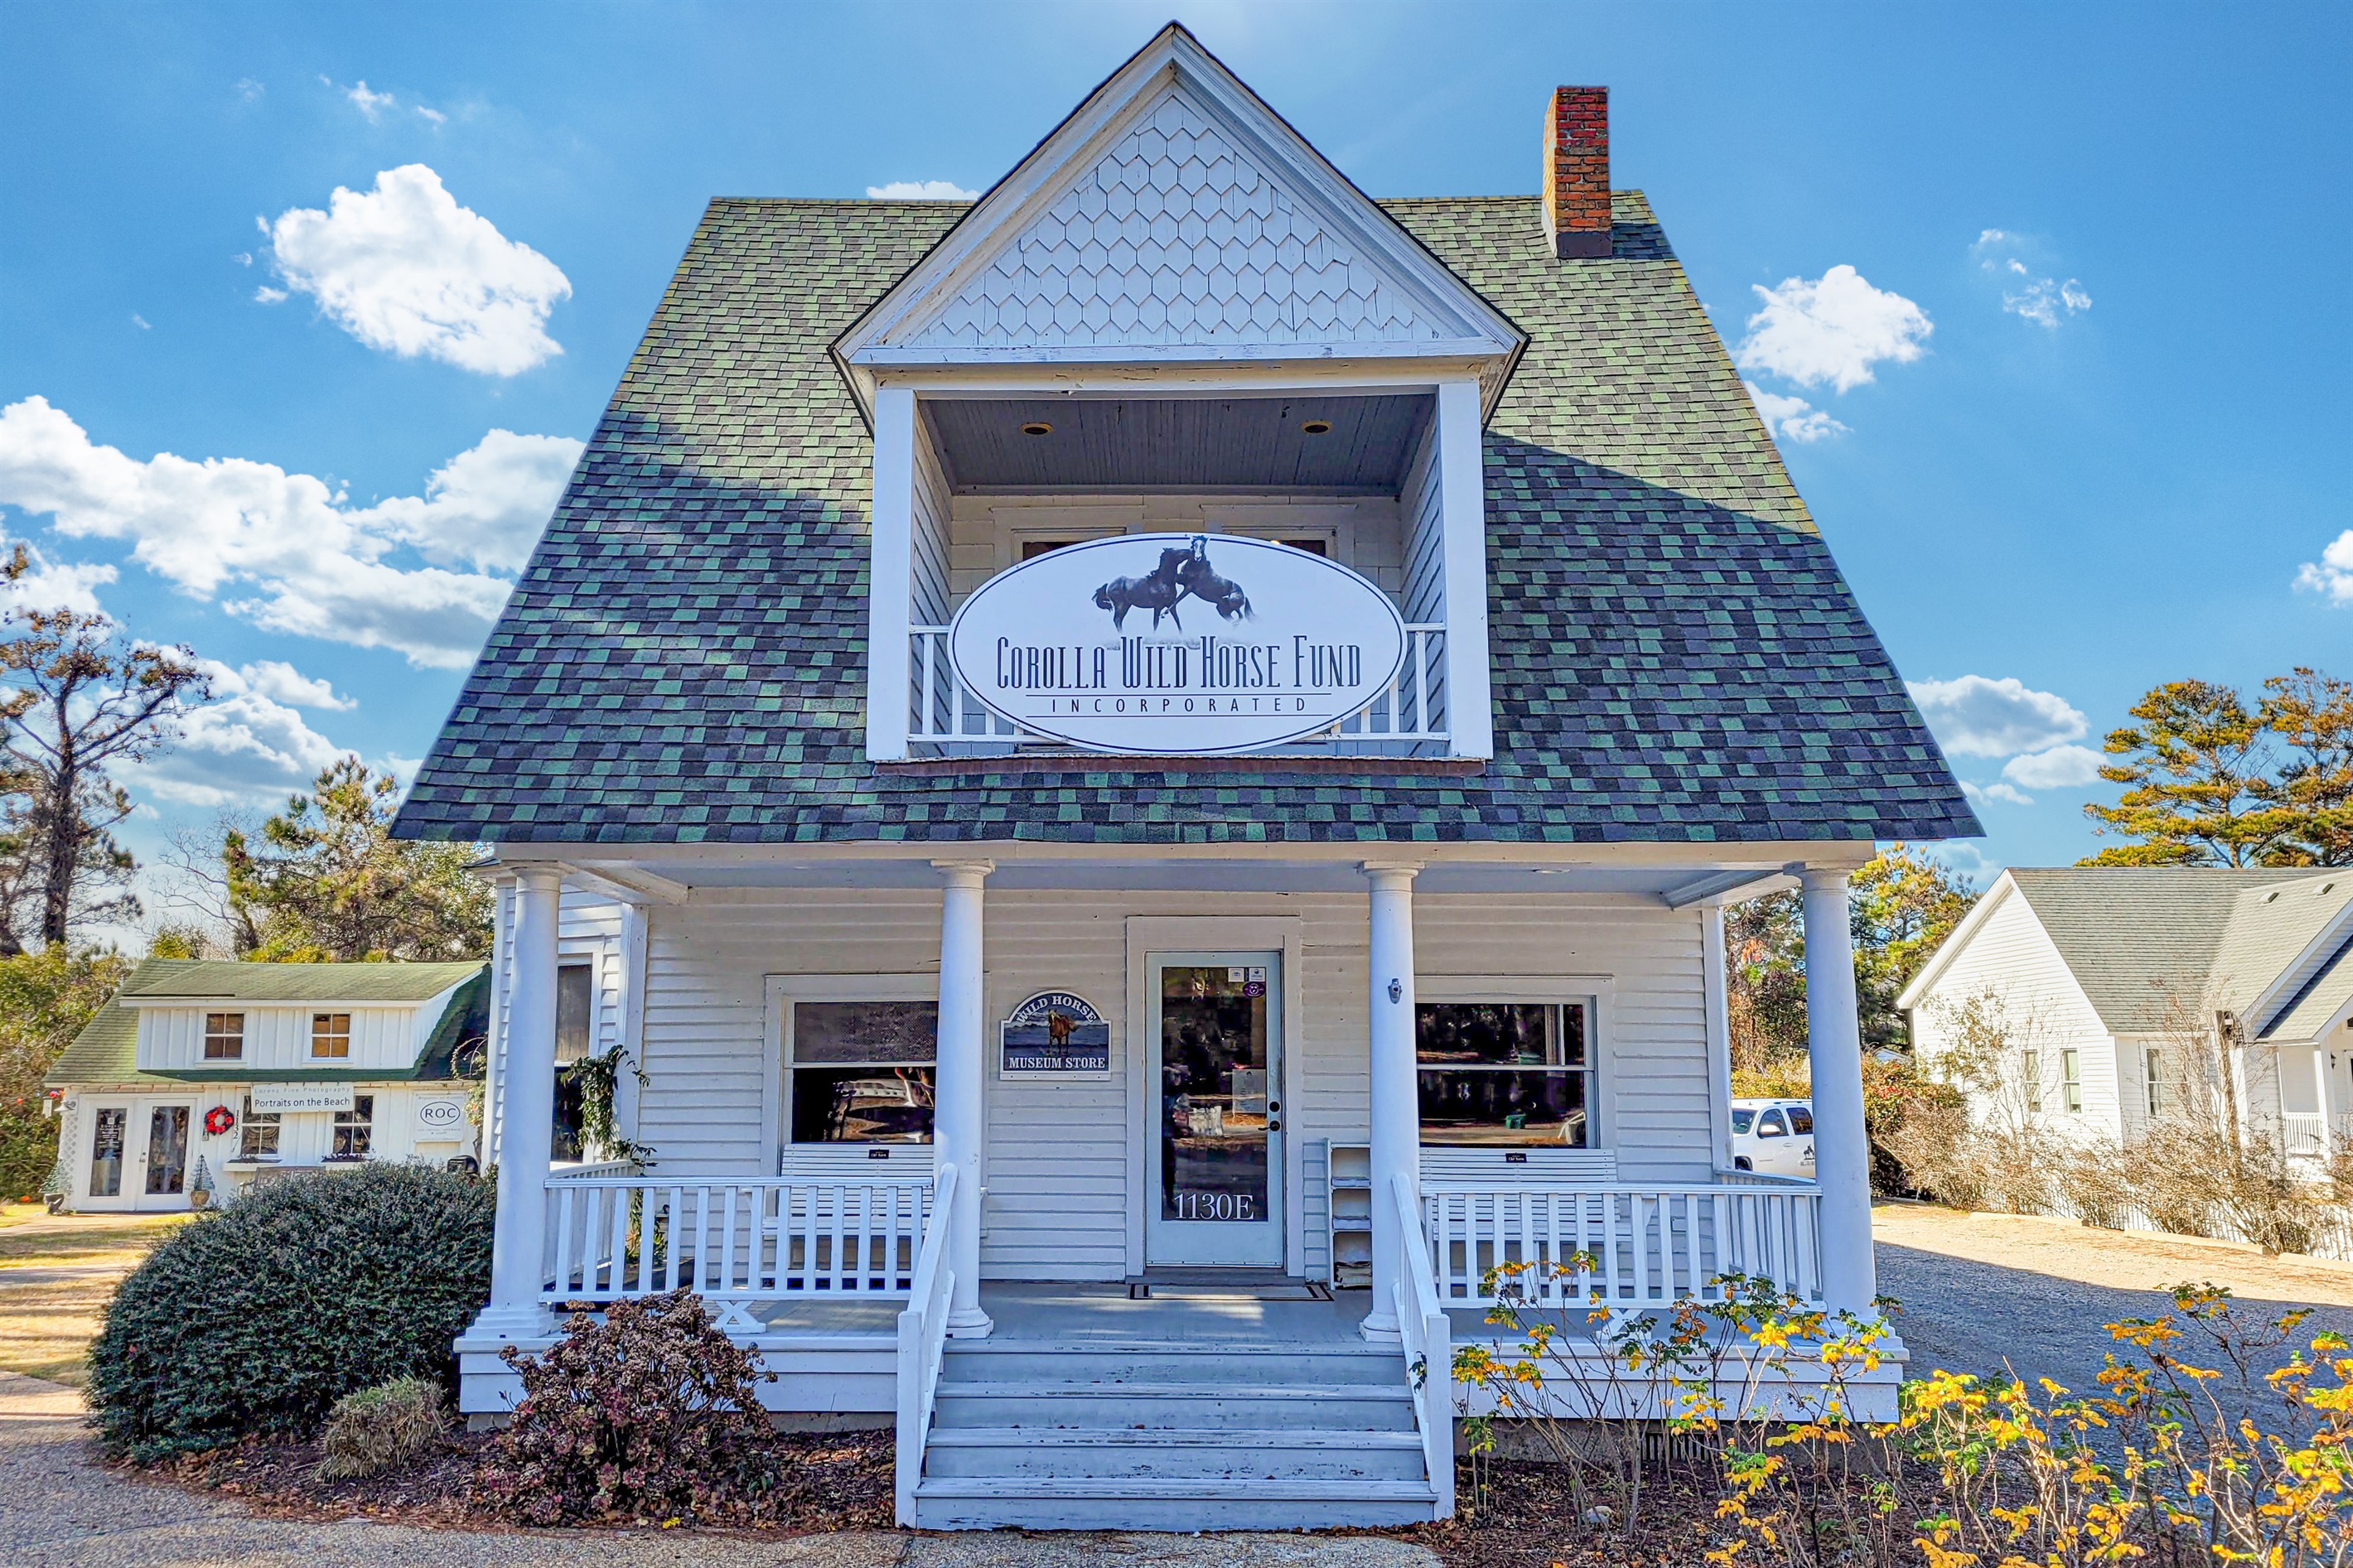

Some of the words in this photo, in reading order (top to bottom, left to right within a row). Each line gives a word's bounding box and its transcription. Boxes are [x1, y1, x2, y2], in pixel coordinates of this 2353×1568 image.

[997, 636, 1107, 689] COROLLA
[1120, 636, 1187, 688] WILD
[1200, 635, 1281, 688] HORSE
[1292, 634, 1361, 688] FUND
[1051, 697, 1306, 712] INCORPORATED
[1016, 997, 1048, 1023] WILD
[1051, 995, 1097, 1023] HORSE
[1008, 1057, 1062, 1069] MUSEUM
[1065, 1057, 1105, 1069] STORE
[254, 1098, 292, 1107] Portraits
[307, 1098, 322, 1107] the
[324, 1097, 350, 1106] Beach
[424, 1107, 457, 1118] ROC
[1173, 1193, 1254, 1220] 1130E
